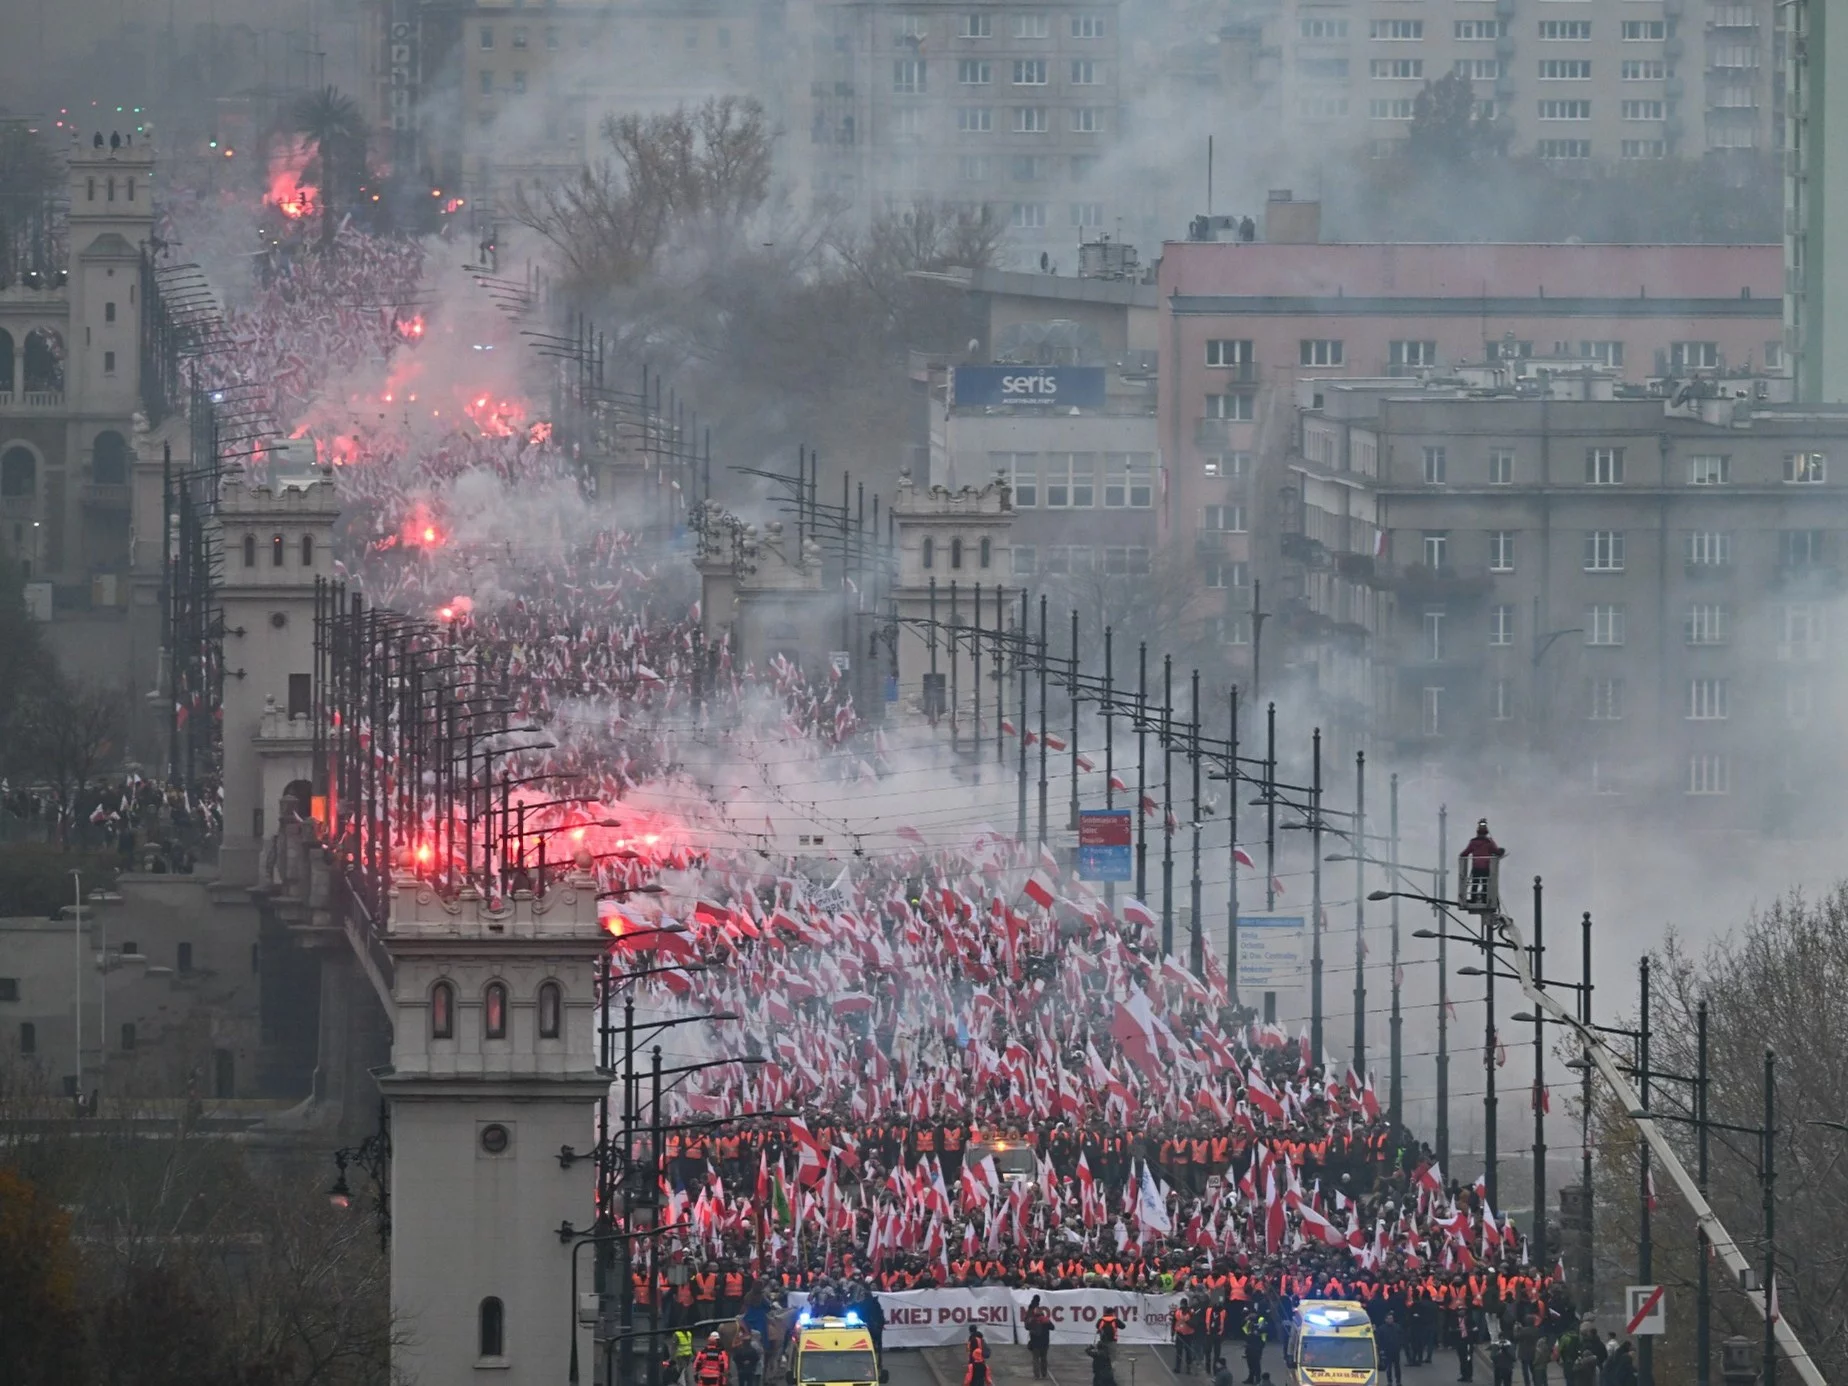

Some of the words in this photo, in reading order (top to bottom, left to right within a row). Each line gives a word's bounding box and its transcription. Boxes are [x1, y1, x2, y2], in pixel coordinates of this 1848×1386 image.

[1002, 369, 1057, 393] seris
[884, 1308, 932, 1325] KIEJ
[939, 1306, 1008, 1324] POLSKI
[1070, 1306, 1097, 1322] TO
